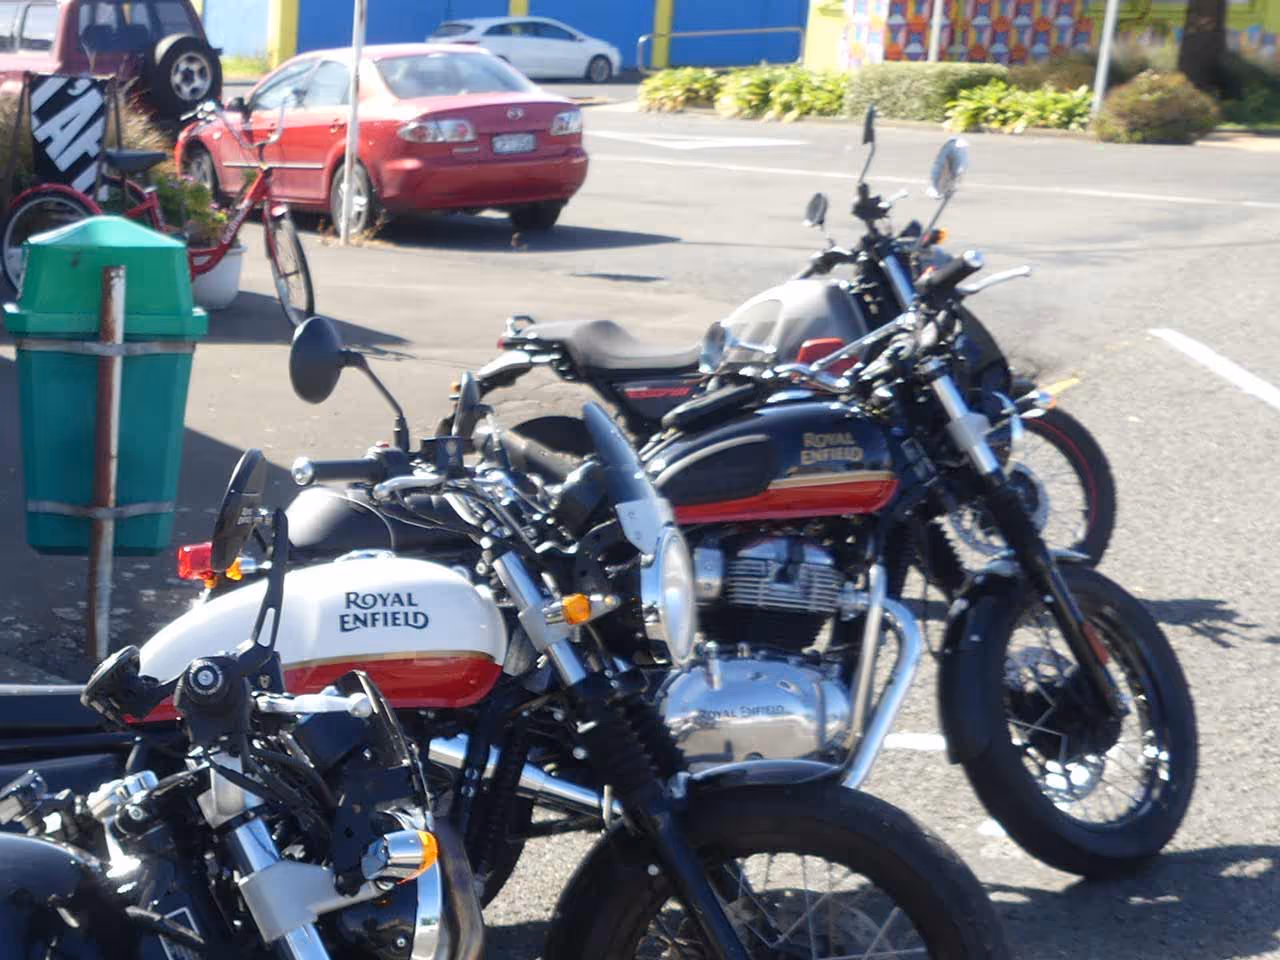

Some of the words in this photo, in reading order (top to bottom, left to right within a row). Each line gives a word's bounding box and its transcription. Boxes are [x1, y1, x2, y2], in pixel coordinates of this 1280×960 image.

[803, 432, 855, 448] ROYAL
[801, 446, 864, 464] ENFIELD
[344, 591, 419, 610] ROYAL
[339, 611, 430, 633] ENFIELD
